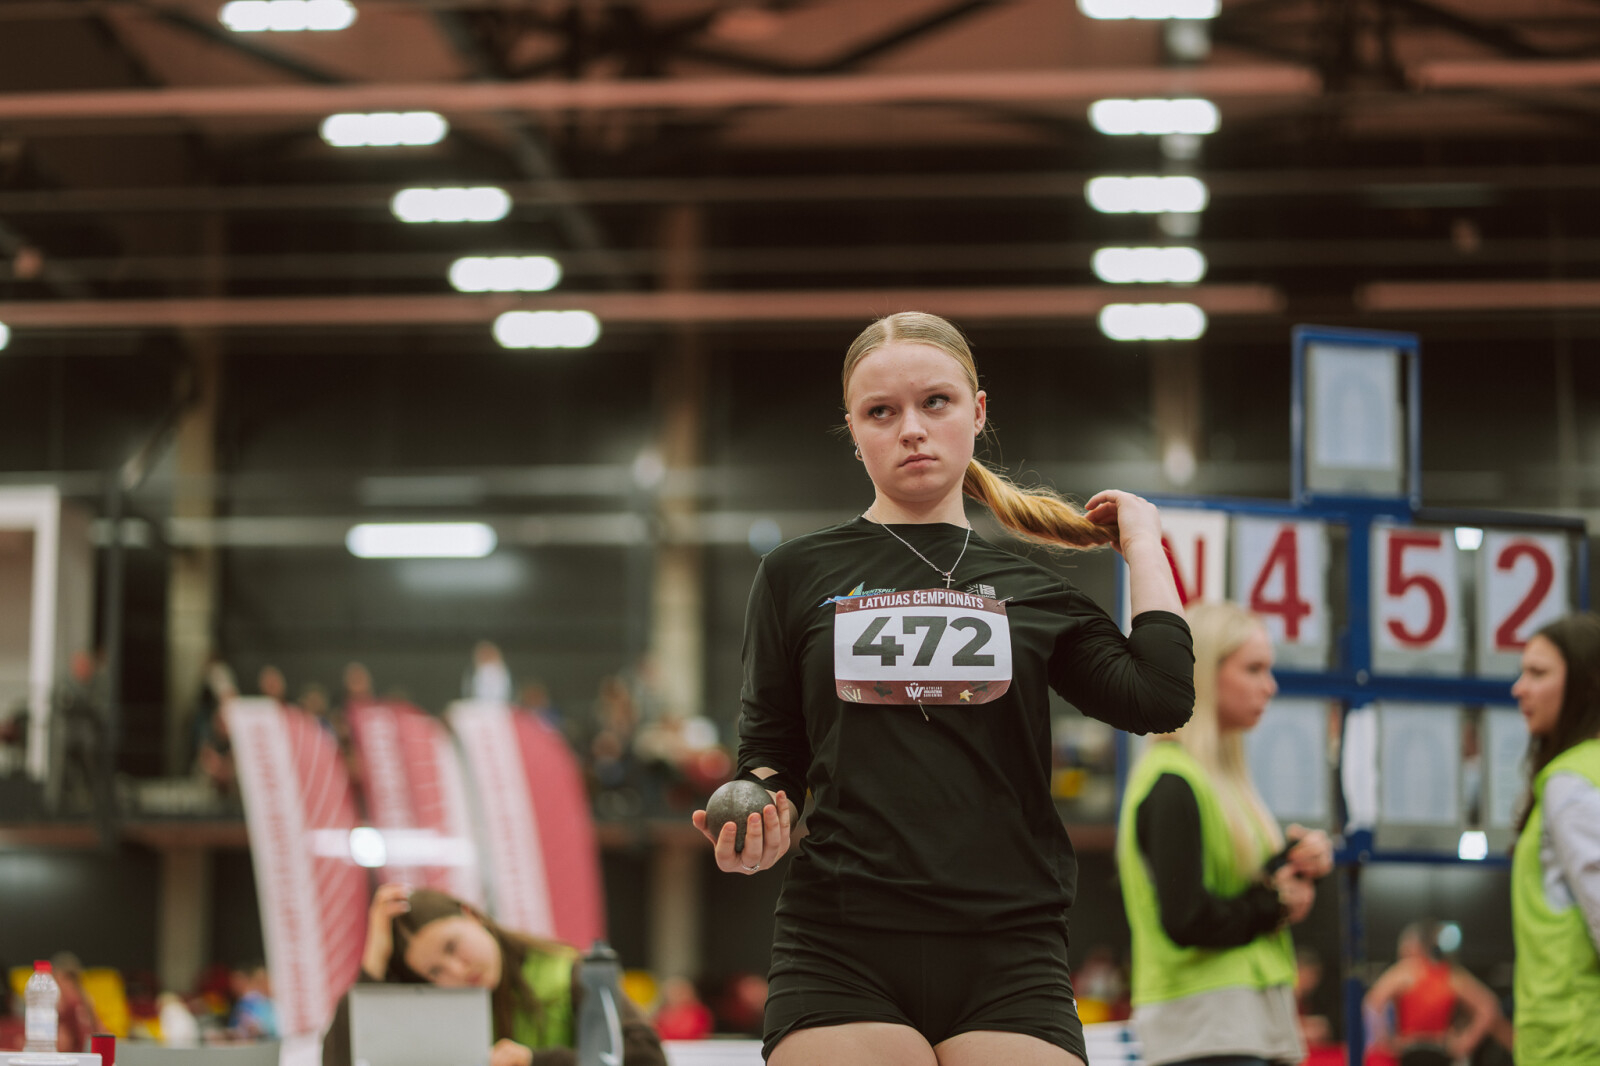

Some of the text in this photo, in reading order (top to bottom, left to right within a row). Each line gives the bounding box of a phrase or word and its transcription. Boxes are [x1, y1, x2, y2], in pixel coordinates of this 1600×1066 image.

[859, 590, 984, 609] LATVIJAS ČEMPIONĀTS
[852, 616, 995, 666] 472
